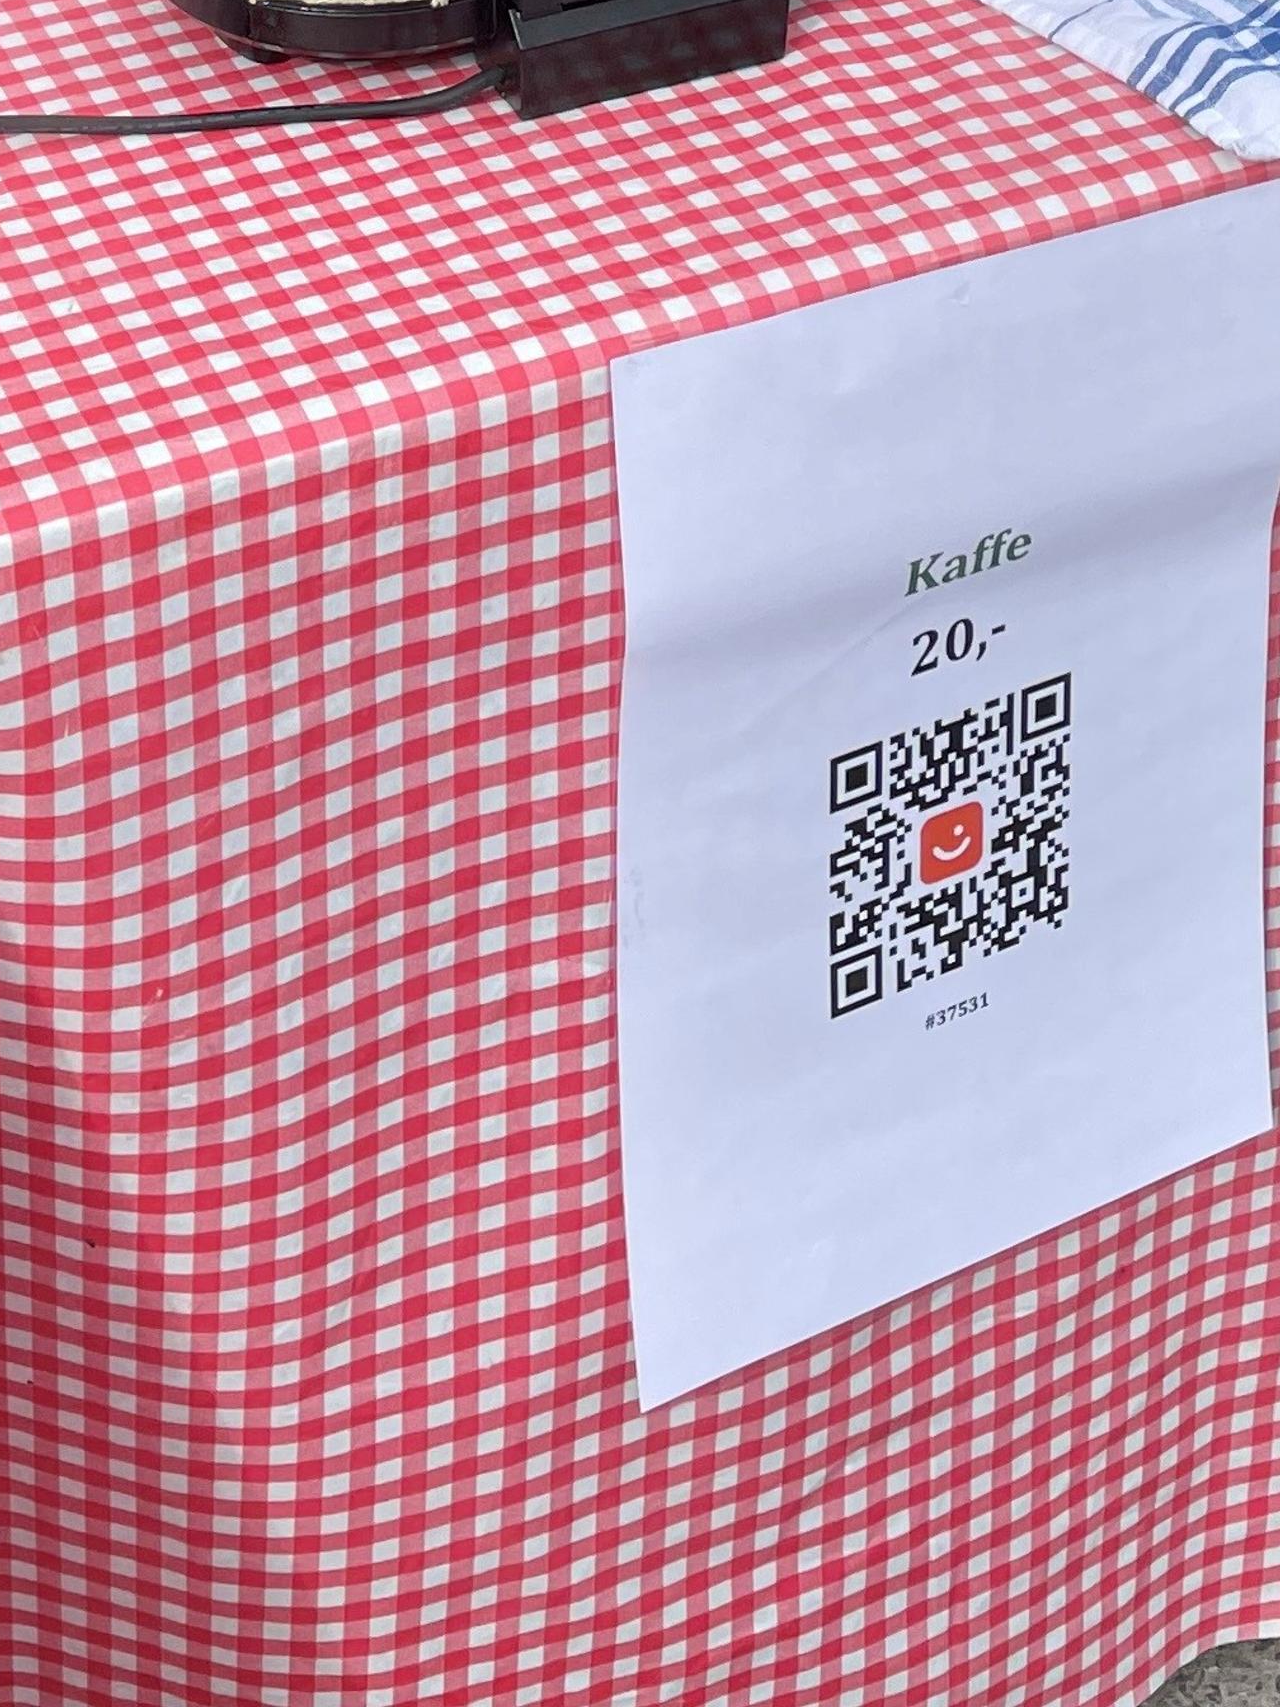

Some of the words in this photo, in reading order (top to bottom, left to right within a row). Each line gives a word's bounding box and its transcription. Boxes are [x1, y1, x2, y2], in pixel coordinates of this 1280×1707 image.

[904, 528, 1032, 597] Kaffe
[910, 617, 1006, 677] 20,-
[924, 992, 990, 1031] #37531
